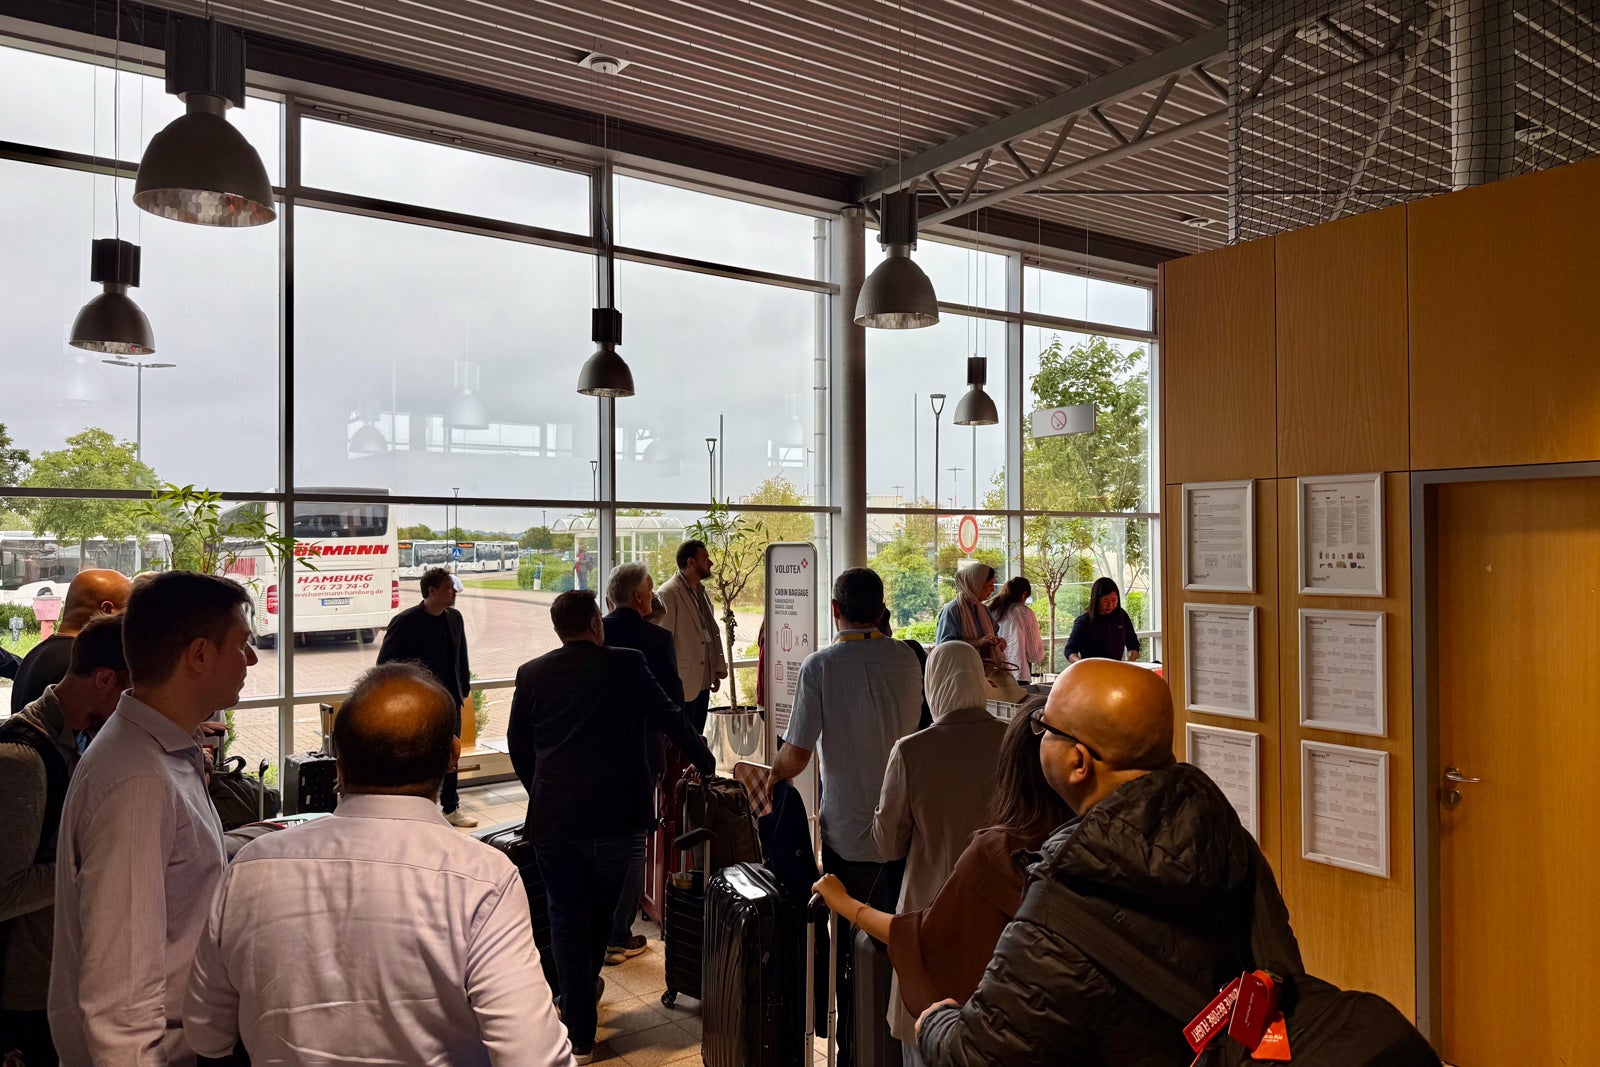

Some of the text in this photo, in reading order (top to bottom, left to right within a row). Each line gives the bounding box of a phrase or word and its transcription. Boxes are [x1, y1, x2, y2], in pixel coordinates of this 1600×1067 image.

[294, 542, 390, 557] ÖRMANN
[774, 564, 801, 574] VOLOTEA
[297, 574, 374, 584] HAMBURG
[774, 588, 809, 597] CABIN BAGGAGE
[1206, 1002, 1228, 1028] BEFORE
[1191, 1019, 1211, 1043] FLIGHT
